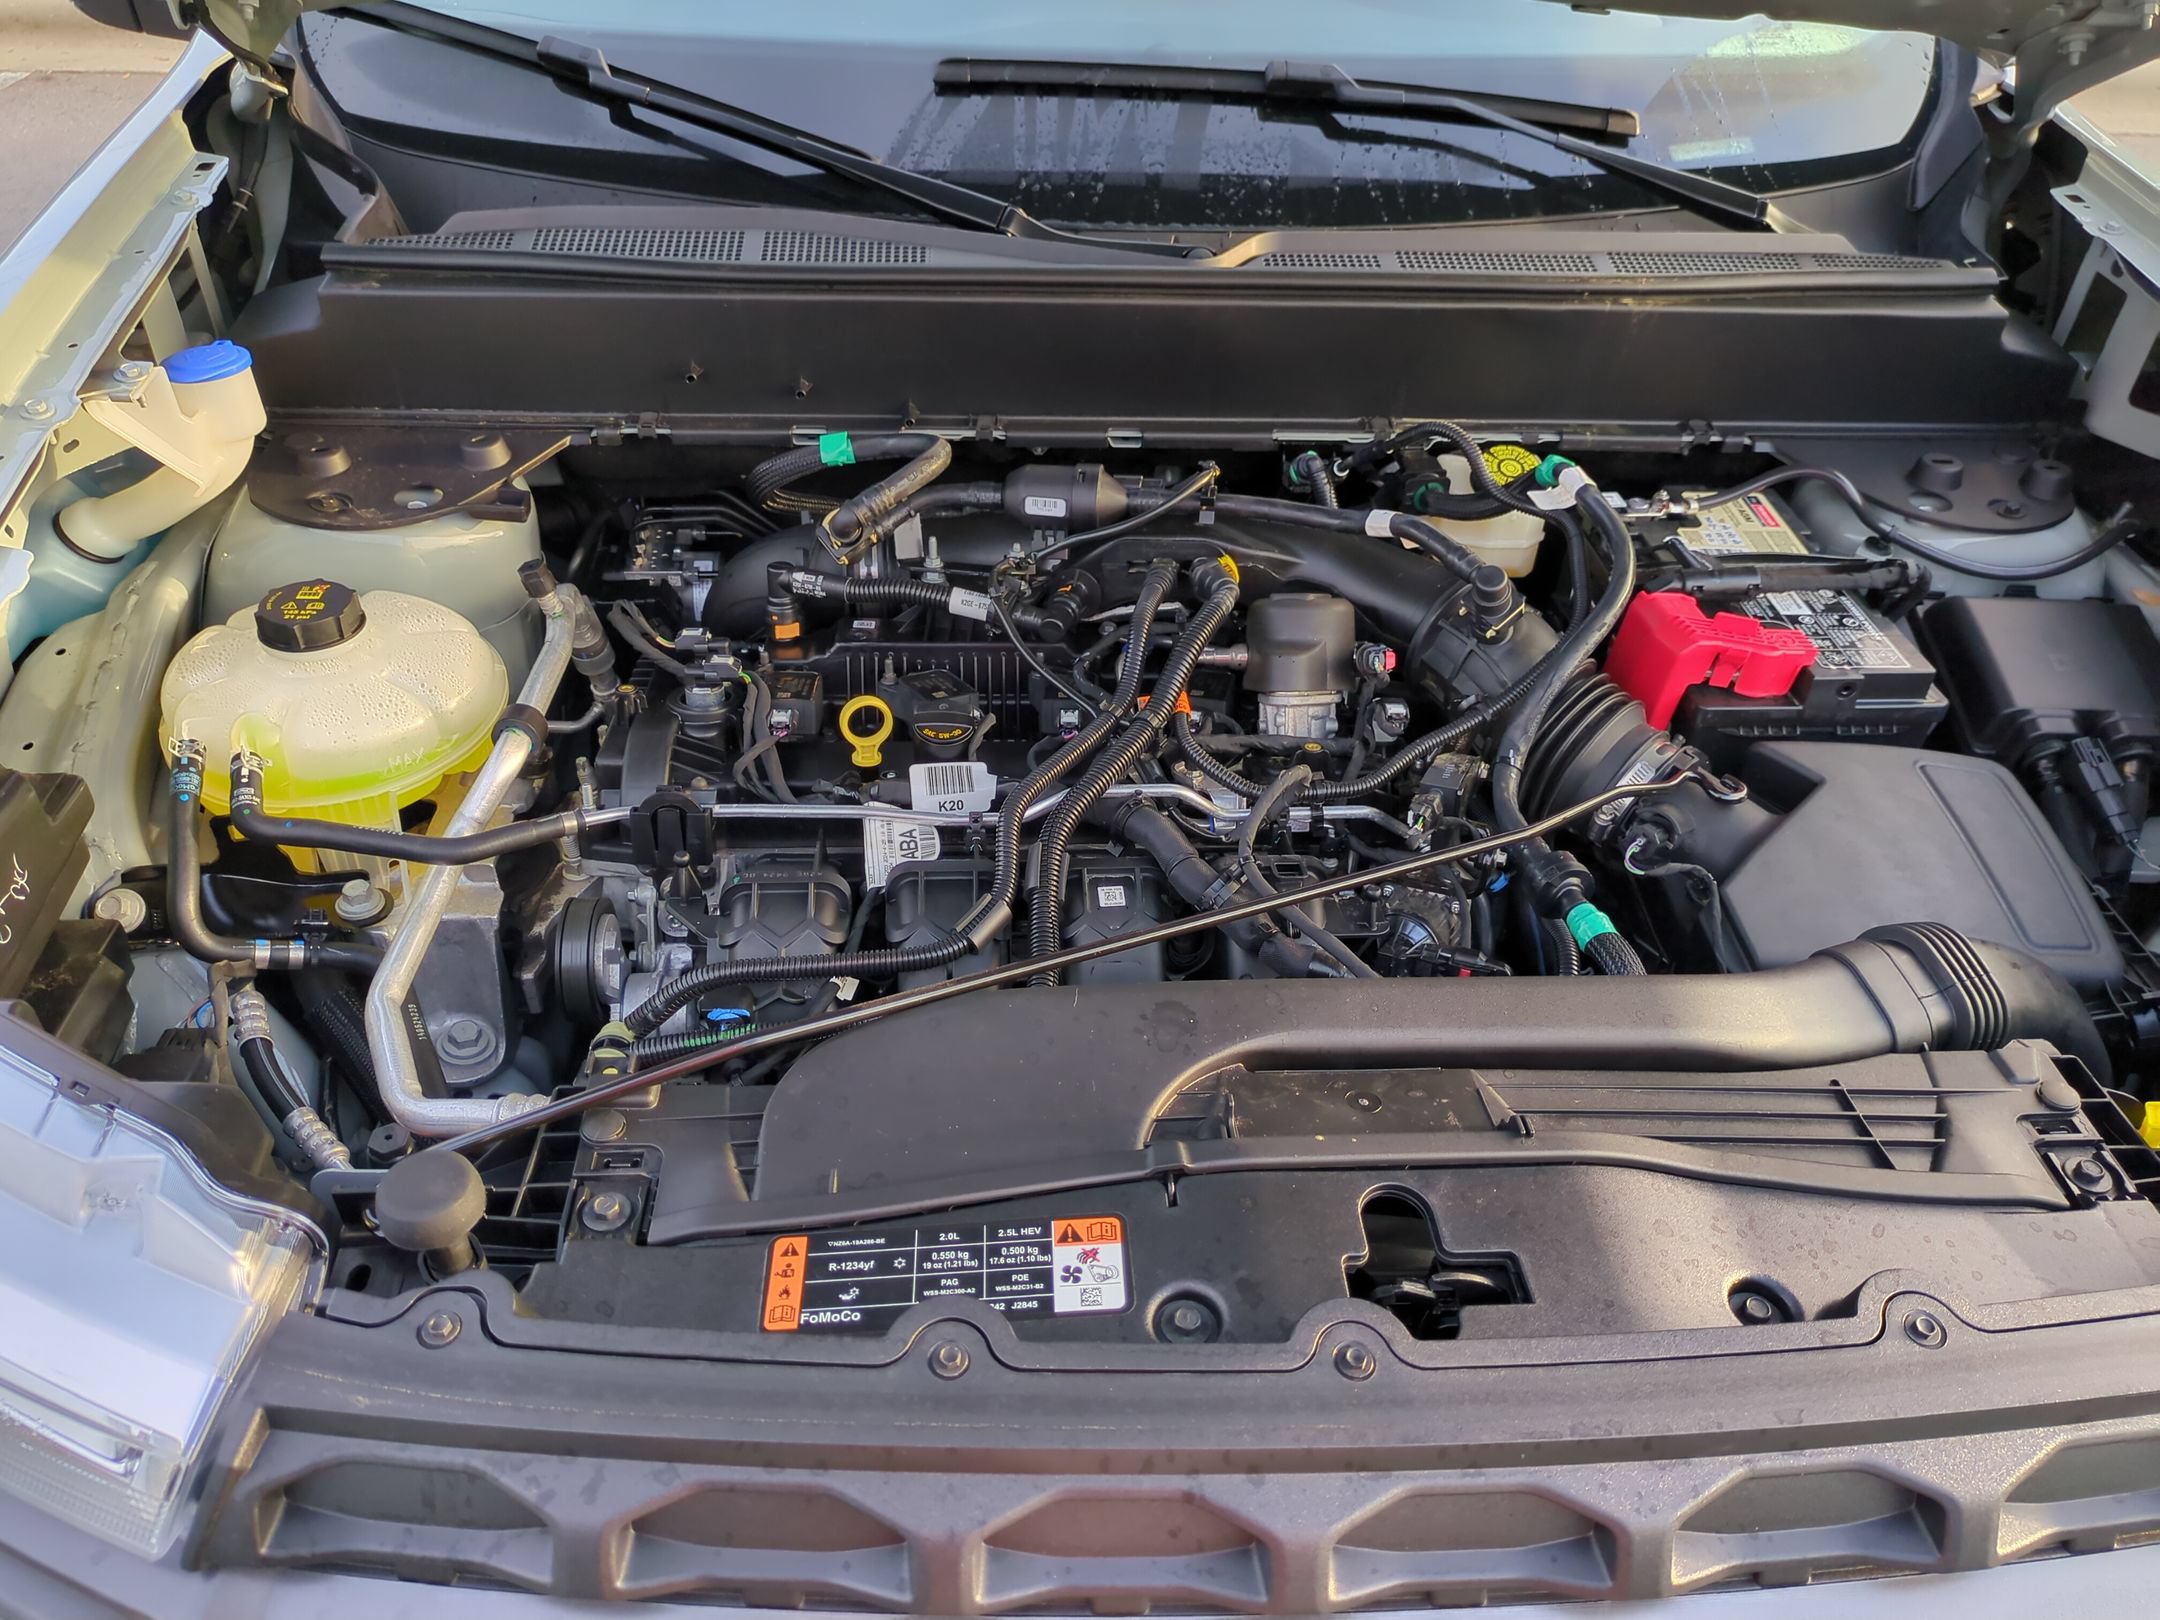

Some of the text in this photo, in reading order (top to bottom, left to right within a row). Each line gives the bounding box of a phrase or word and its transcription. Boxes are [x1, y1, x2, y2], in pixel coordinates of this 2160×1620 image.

[388, 747, 424, 773] MAX
[938, 800, 964, 812] K20
[898, 828, 919, 859] ABA
[939, 1232, 960, 1241] 2.0L
[998, 1227, 1041, 1237] 2.5L HEV
[1001, 1246, 1038, 1255] 0.500 kg
[931, 1251, 969, 1260] 0.550 kg
[922, 1261, 932, 1269] 19
[989, 1256, 1005, 1265] 17.6
[829, 1260, 875, 1272] R-1234yf
[1011, 1273, 1030, 1281] POE
[940, 1278, 959, 1287] PAG
[1011, 1300, 1039, 1310] J2845
[799, 1310, 861, 1324] FoMoCo
